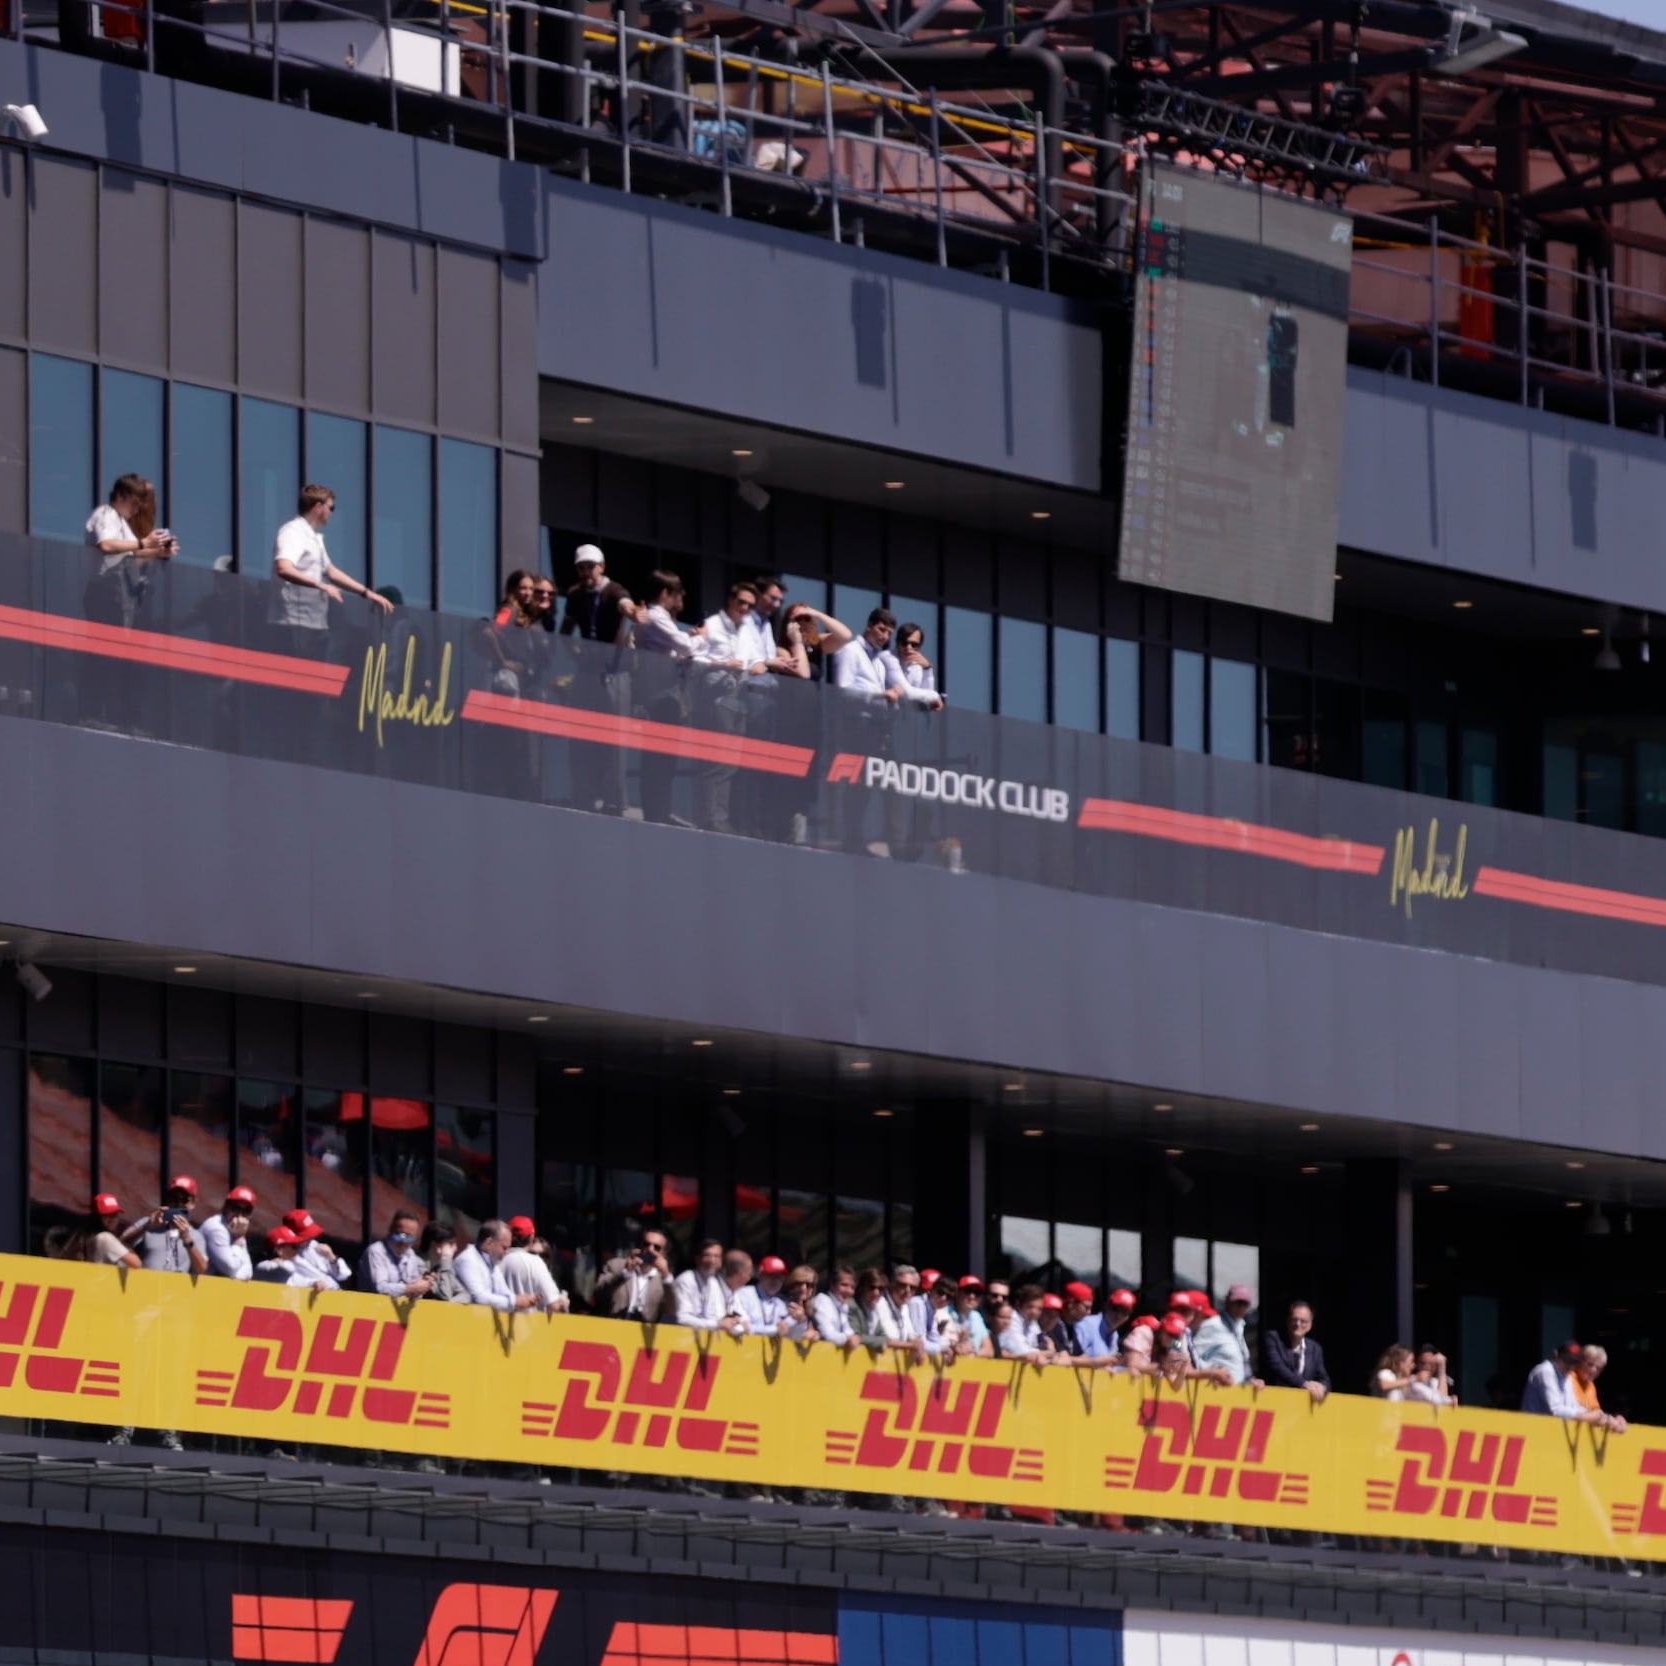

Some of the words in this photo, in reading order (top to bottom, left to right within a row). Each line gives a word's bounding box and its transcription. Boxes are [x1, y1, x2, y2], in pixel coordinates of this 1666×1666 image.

[358, 636, 455, 747] Madrid
[866, 756, 995, 809] PADDOCK
[999, 780, 1070, 822] CLUB
[1391, 818, 1468, 918] Madrid
[232, 1306, 419, 1425] DHL
[554, 1340, 729, 1452] DHL
[856, 1371, 1016, 1477] DHL
[1134, 1398, 1284, 1502] DHL
[1393, 1424, 1533, 1524] DHL
